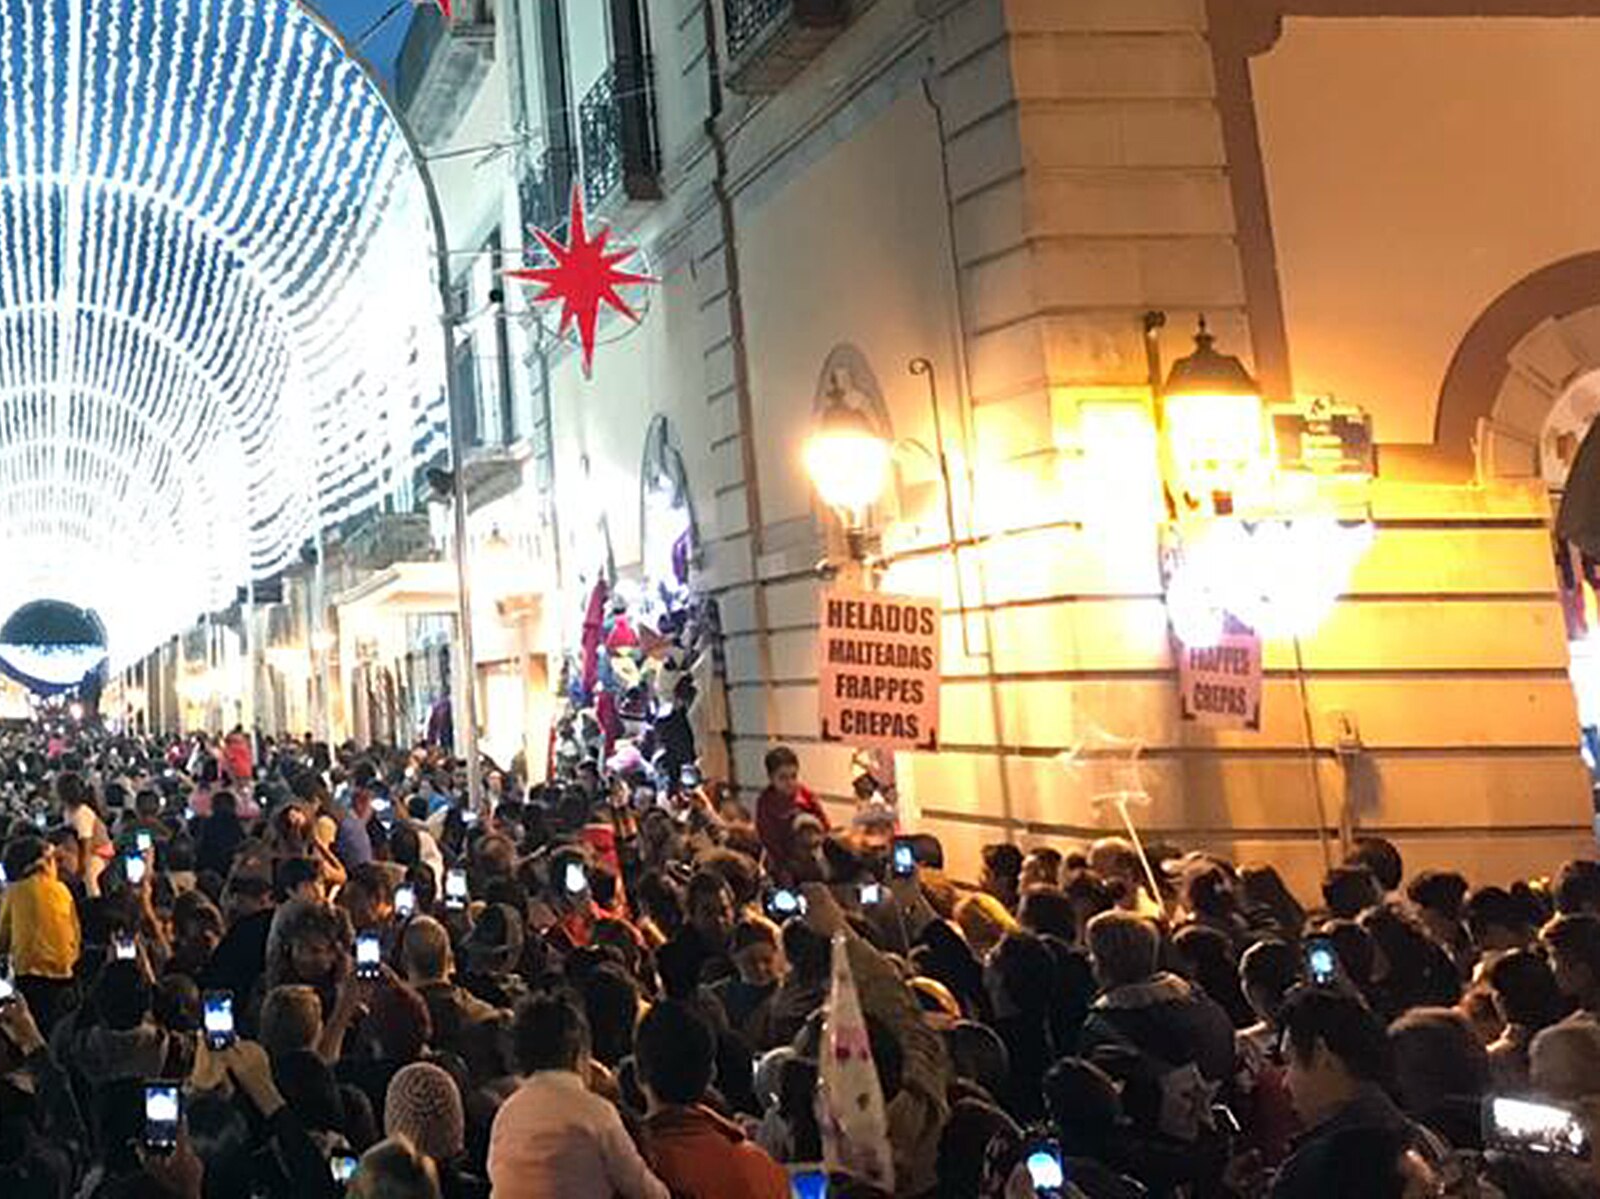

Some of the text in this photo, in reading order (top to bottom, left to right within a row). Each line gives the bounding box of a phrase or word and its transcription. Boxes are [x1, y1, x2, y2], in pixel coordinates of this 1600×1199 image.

[827, 599, 934, 636] HELADOS
[828, 638, 933, 671] MALTEADAS
[836, 673, 924, 705] FRAPPES
[1194, 682, 1247, 717] CREPAS
[840, 709, 919, 739] CREPAS
